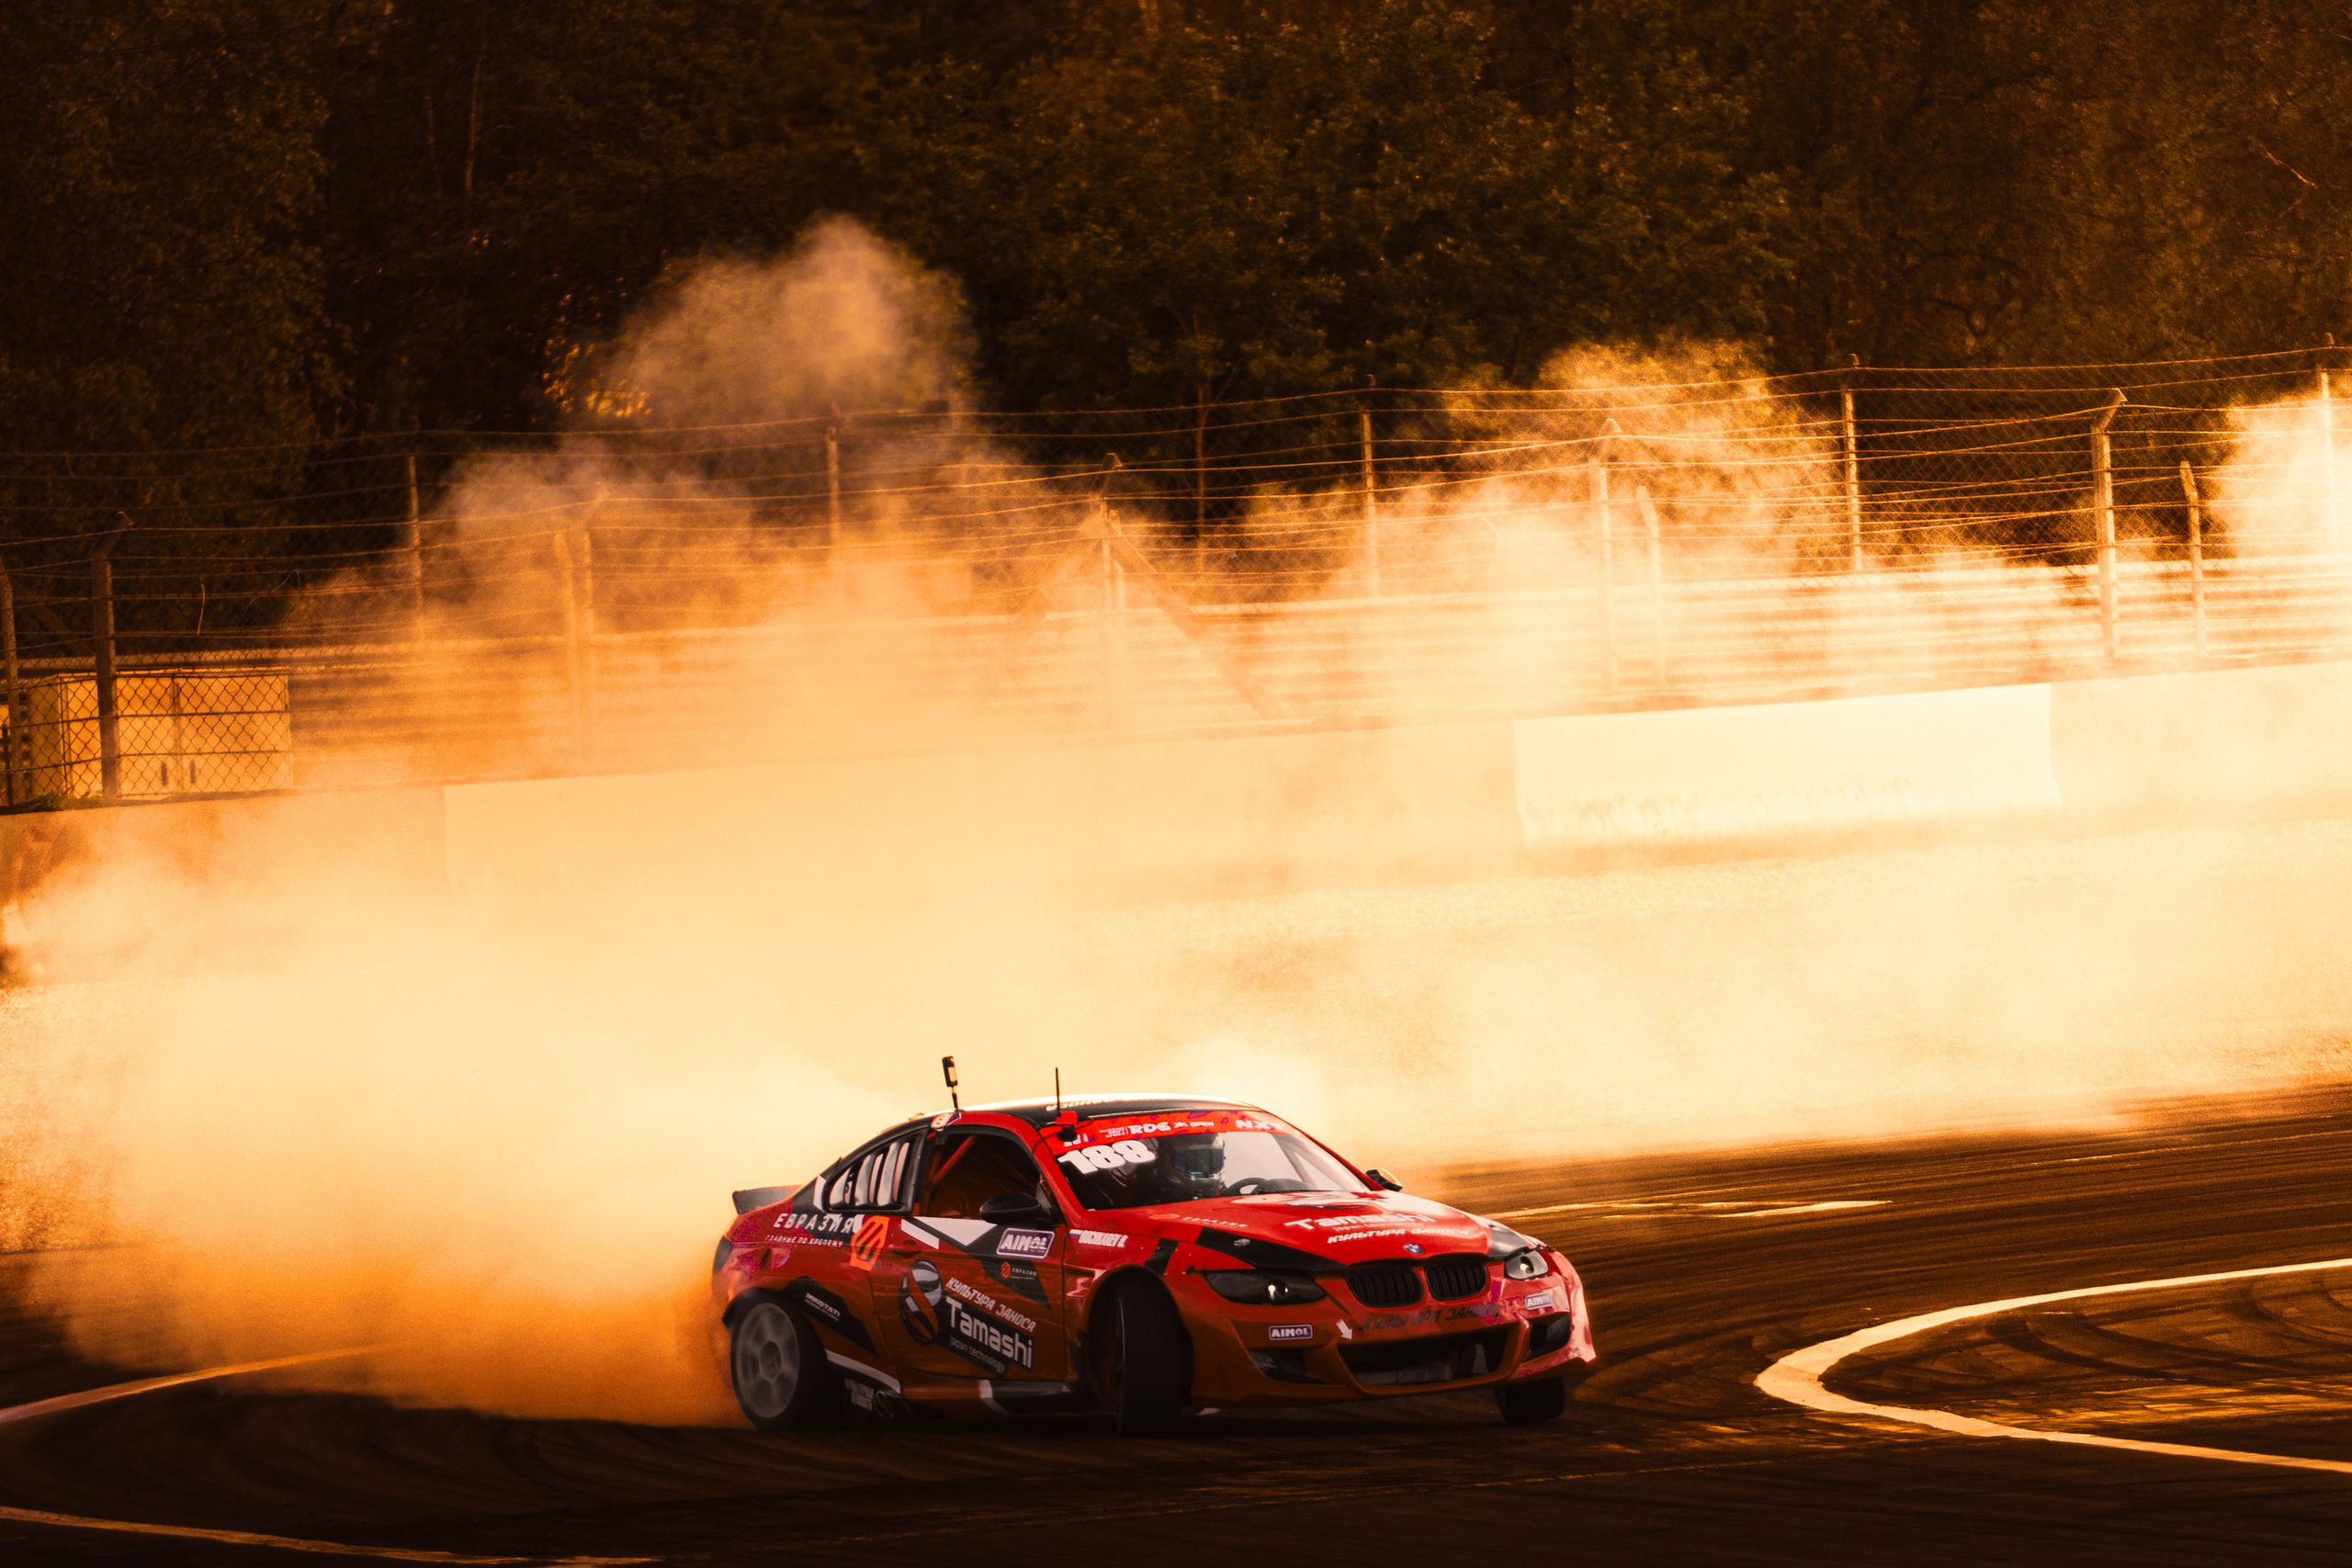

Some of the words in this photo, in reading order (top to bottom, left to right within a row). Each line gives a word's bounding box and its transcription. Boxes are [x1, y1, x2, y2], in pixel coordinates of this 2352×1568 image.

[1057, 1140, 1157, 1174] 188
[773, 1213, 854, 1233] ЕВРАЗИЯ
[1284, 1213, 1436, 1230] Tamashi
[1328, 1228, 1406, 1244] КУЛЬТУРА
[945, 1277, 996, 1311] КУЛЬТУРА
[996, 1303, 1037, 1333] ЗАНОСА
[945, 1296, 1033, 1369] Tamashi
[1272, 1327, 1309, 1338] AIMOL
